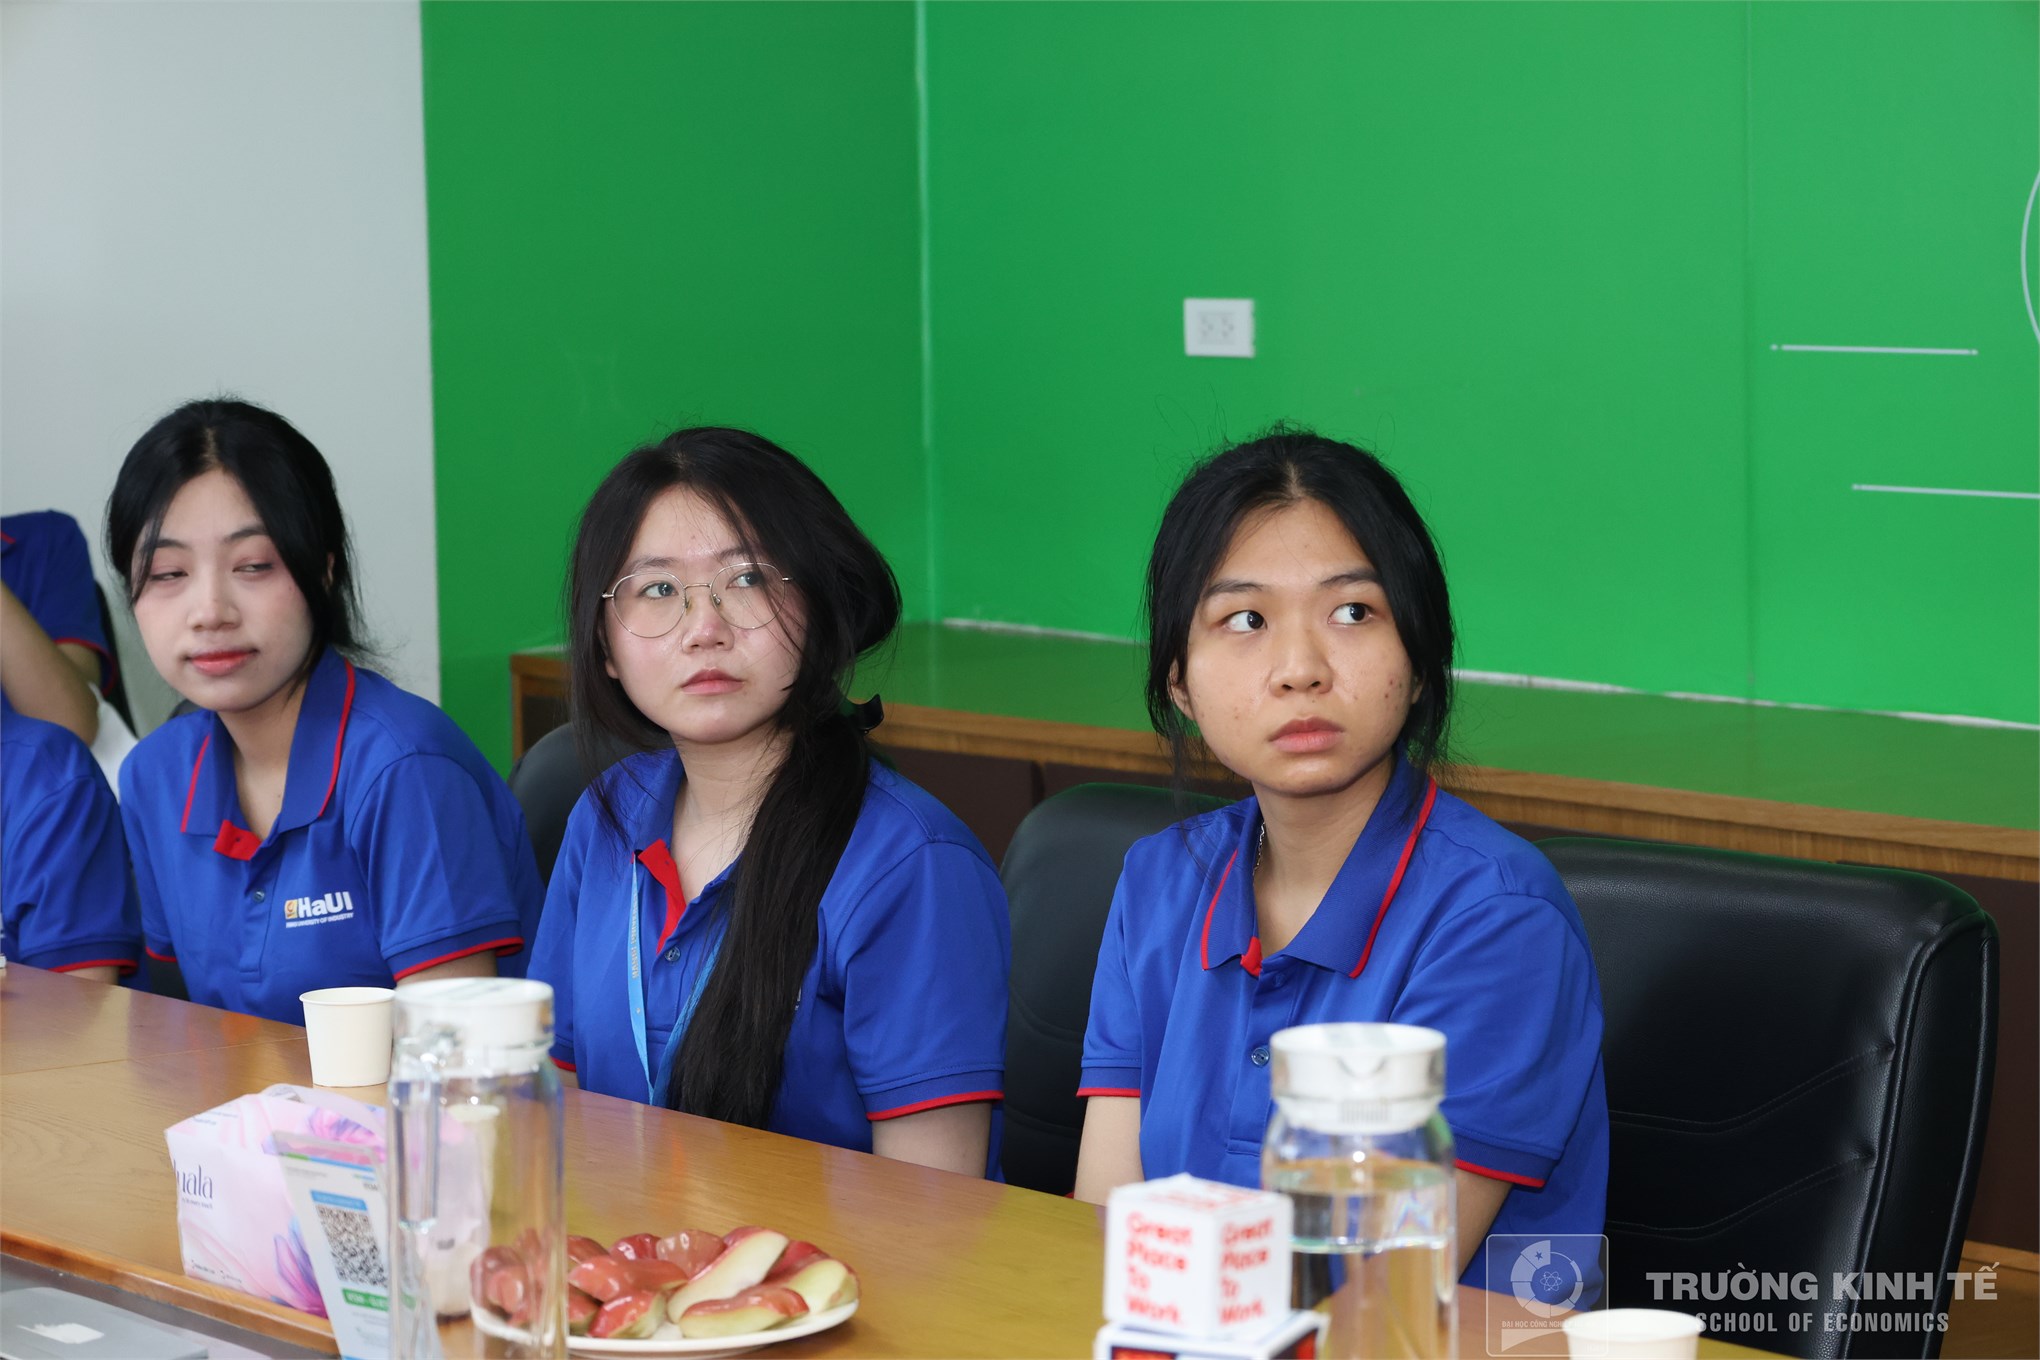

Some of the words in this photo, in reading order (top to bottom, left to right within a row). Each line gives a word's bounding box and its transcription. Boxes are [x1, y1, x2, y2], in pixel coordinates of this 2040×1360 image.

[298, 891, 353, 918] HaUI
[1126, 1212, 1192, 1246] Great
[1221, 1218, 1273, 1246] Great
[1127, 1239, 1187, 1272] Place
[1221, 1248, 1269, 1271] Place
[1127, 1263, 1150, 1291] To
[1221, 1276, 1239, 1299] To
